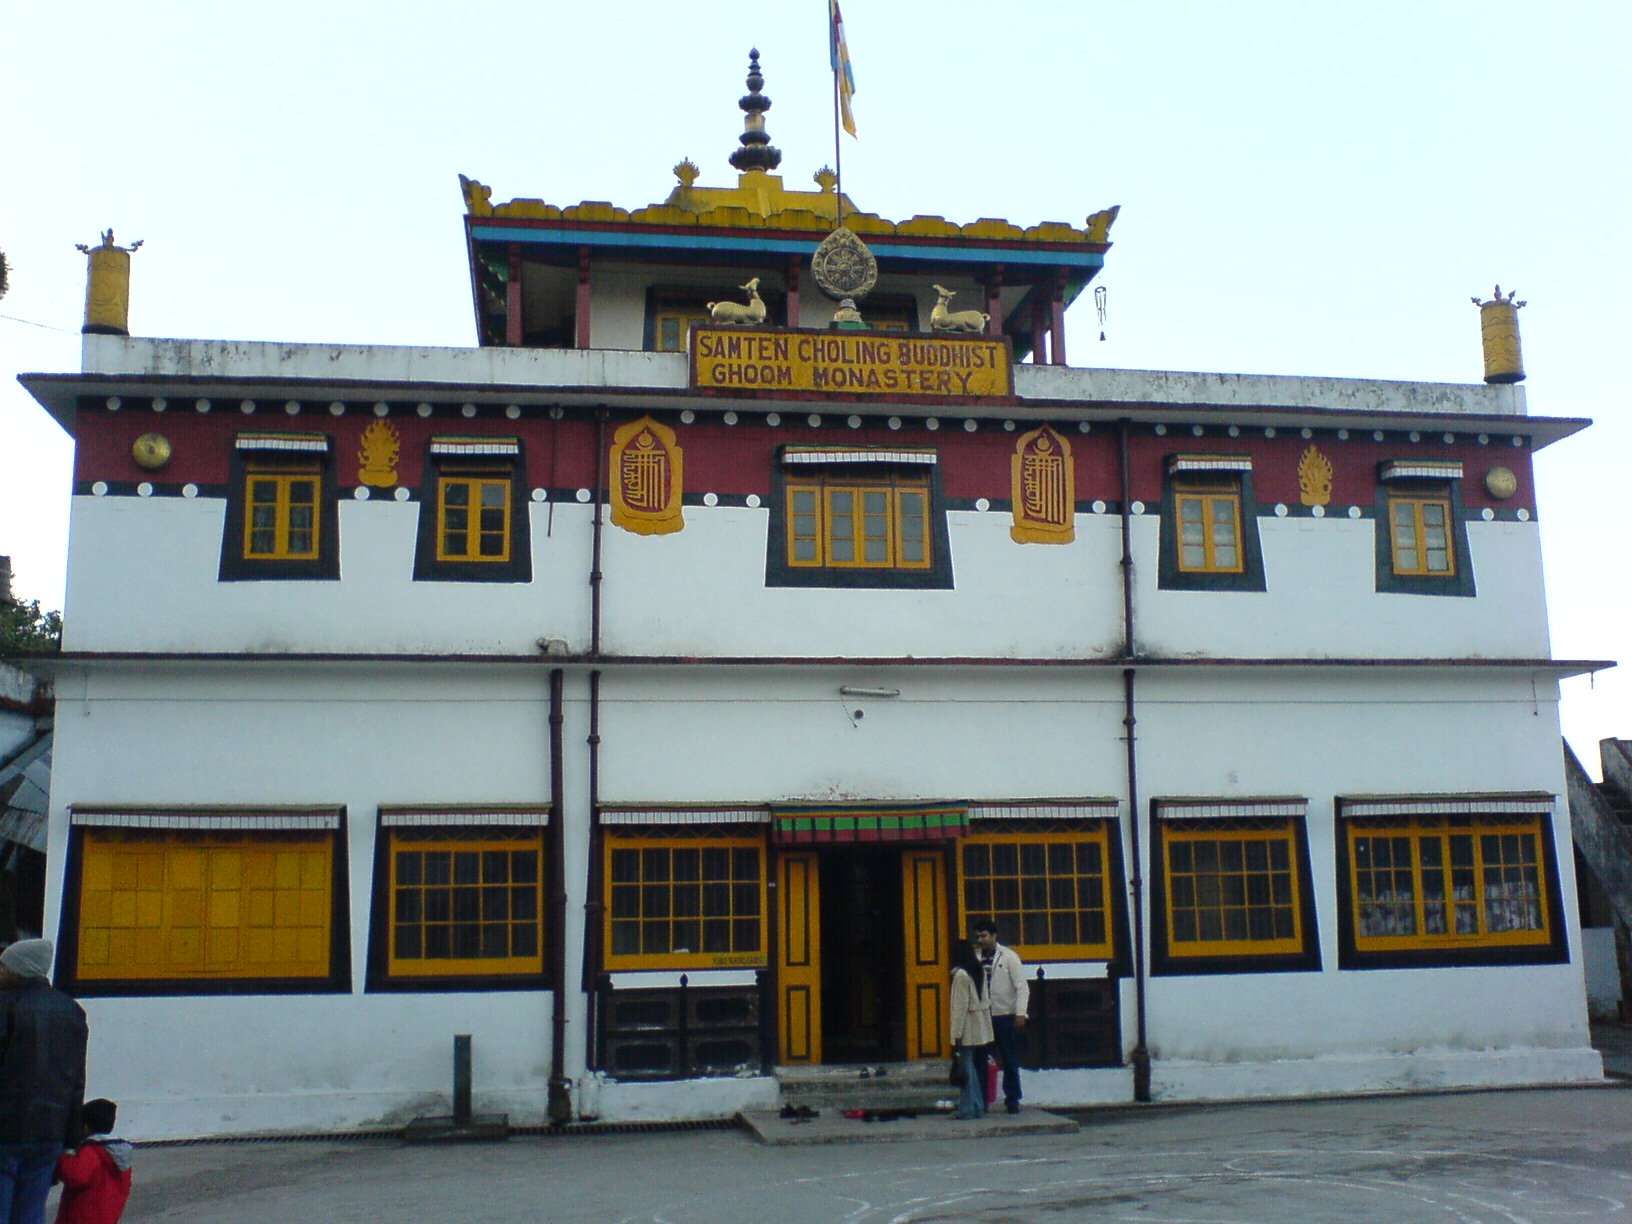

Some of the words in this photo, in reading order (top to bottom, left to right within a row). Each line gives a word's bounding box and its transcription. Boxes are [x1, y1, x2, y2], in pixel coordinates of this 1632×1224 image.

[700, 335, 790, 361] SAMTEN
[799, 338, 892, 365] CHOLING
[900, 342, 998, 369] BUDDHIST
[711, 363, 793, 386] GHOOM
[813, 367, 974, 394] MONASTERY
